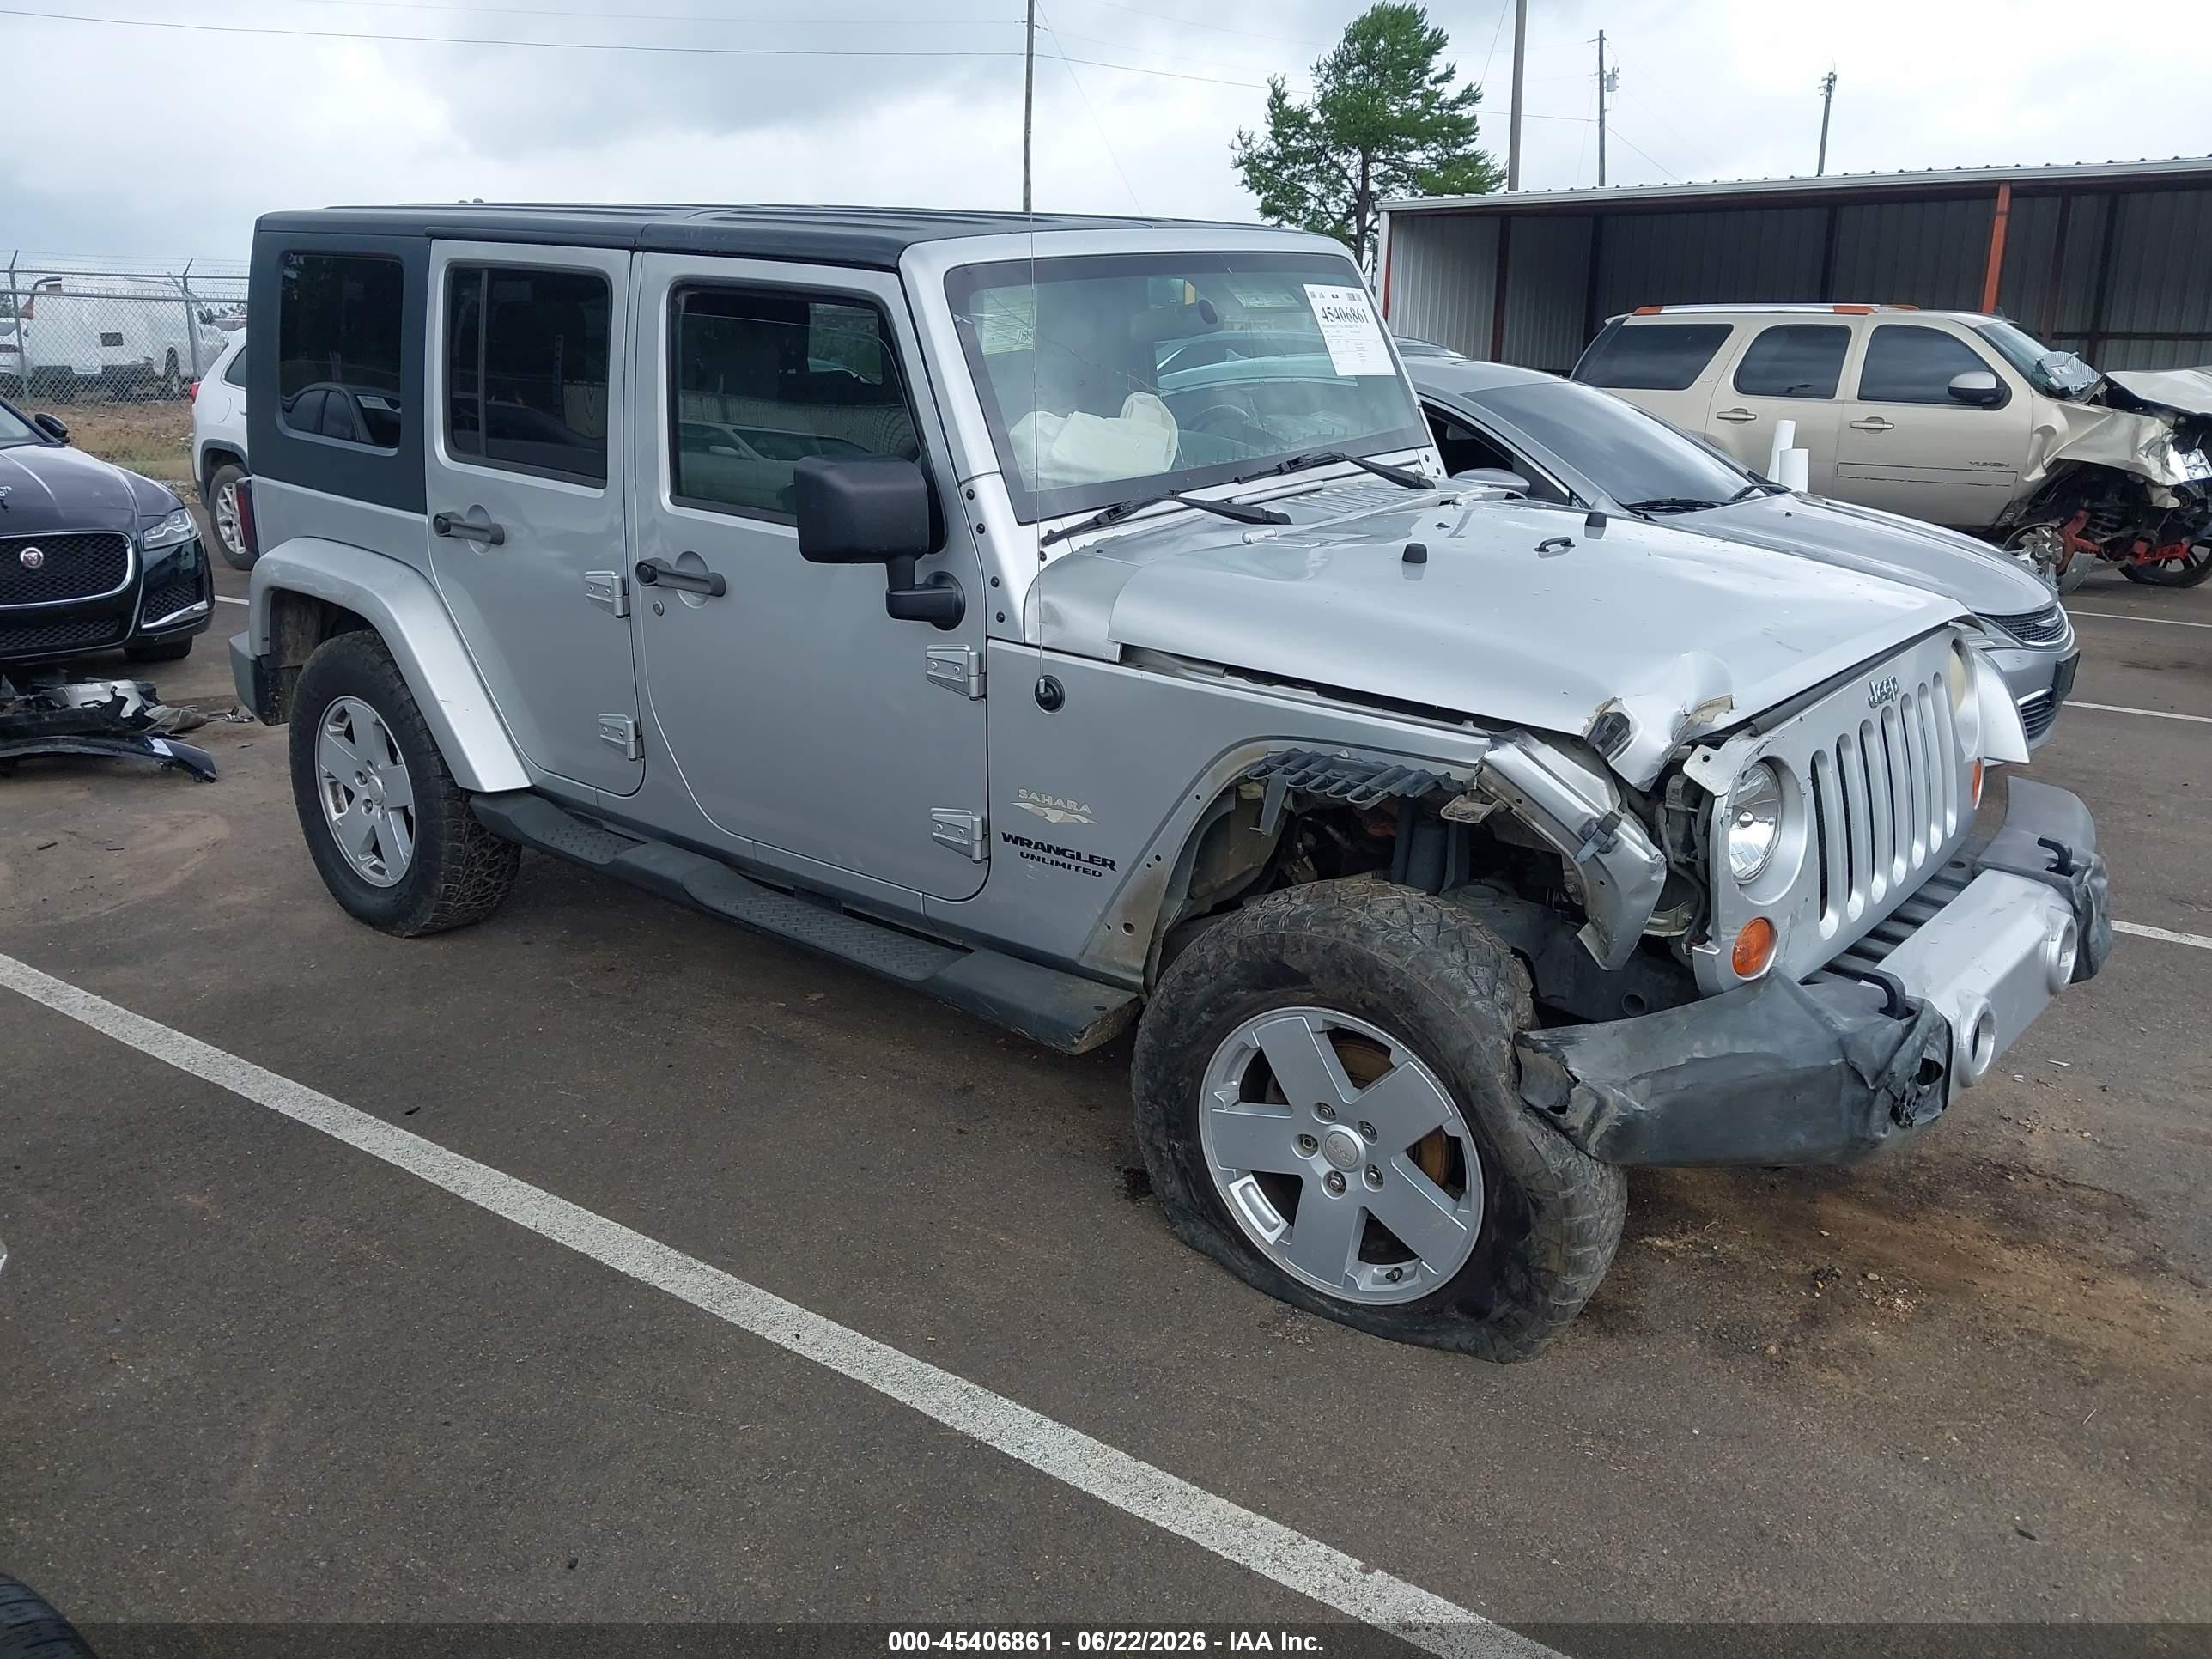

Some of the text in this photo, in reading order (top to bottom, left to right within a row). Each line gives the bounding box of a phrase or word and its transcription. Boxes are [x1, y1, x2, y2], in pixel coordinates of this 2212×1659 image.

[1322, 306, 1370, 324] 45406861
[1868, 676, 1899, 709] Jeep
[1018, 788, 1092, 815] SAHARA
[1001, 831, 1117, 872] WRANGLER
[1019, 851, 1103, 878] UNLIMITED
